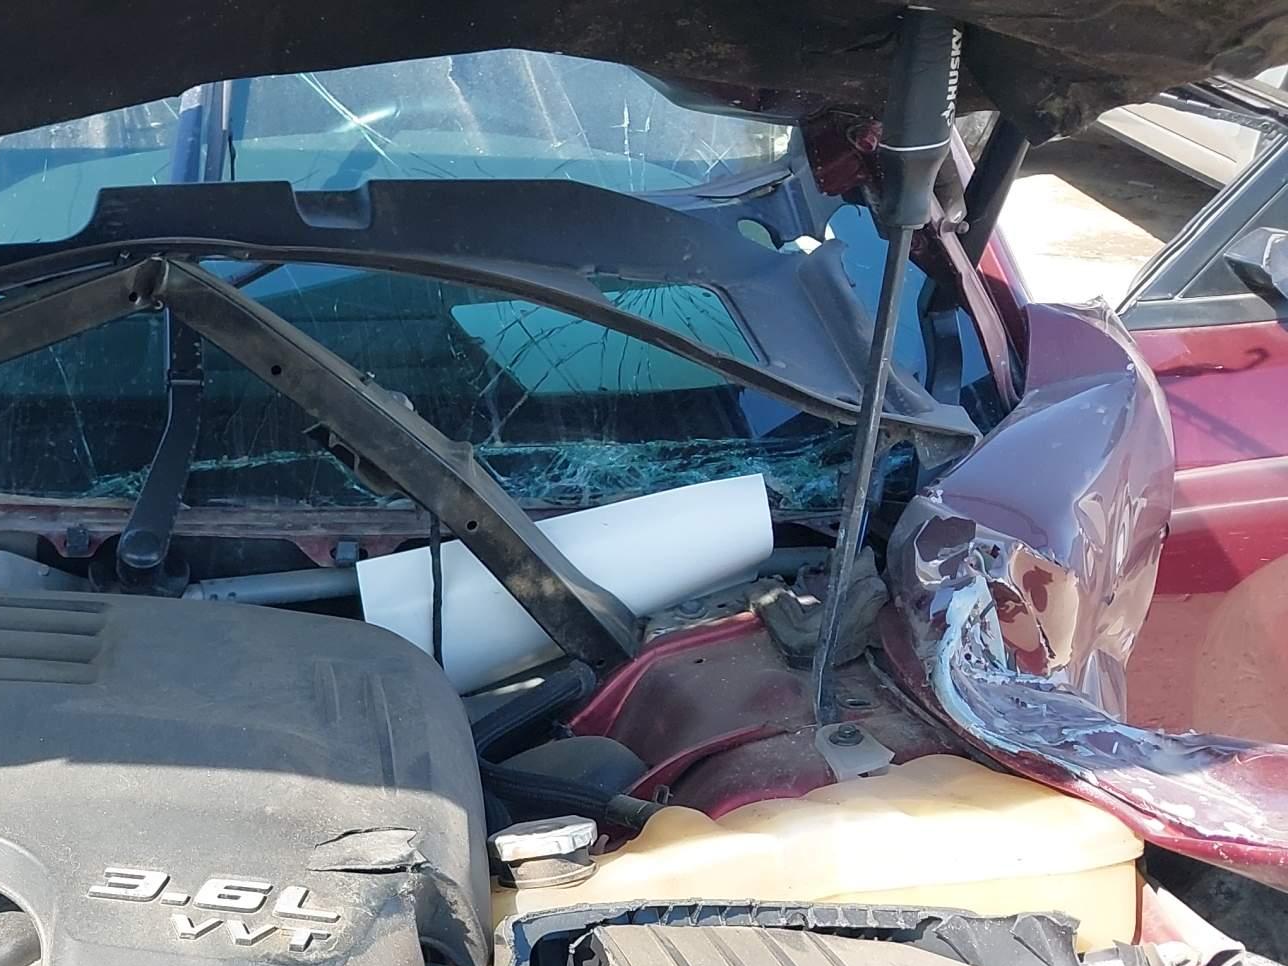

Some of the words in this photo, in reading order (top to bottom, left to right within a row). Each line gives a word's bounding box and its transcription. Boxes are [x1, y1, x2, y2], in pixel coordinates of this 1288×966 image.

[946, 28, 962, 101] HUSKY
[87, 866, 342, 924] 3.6L
[171, 913, 332, 952] VVT
